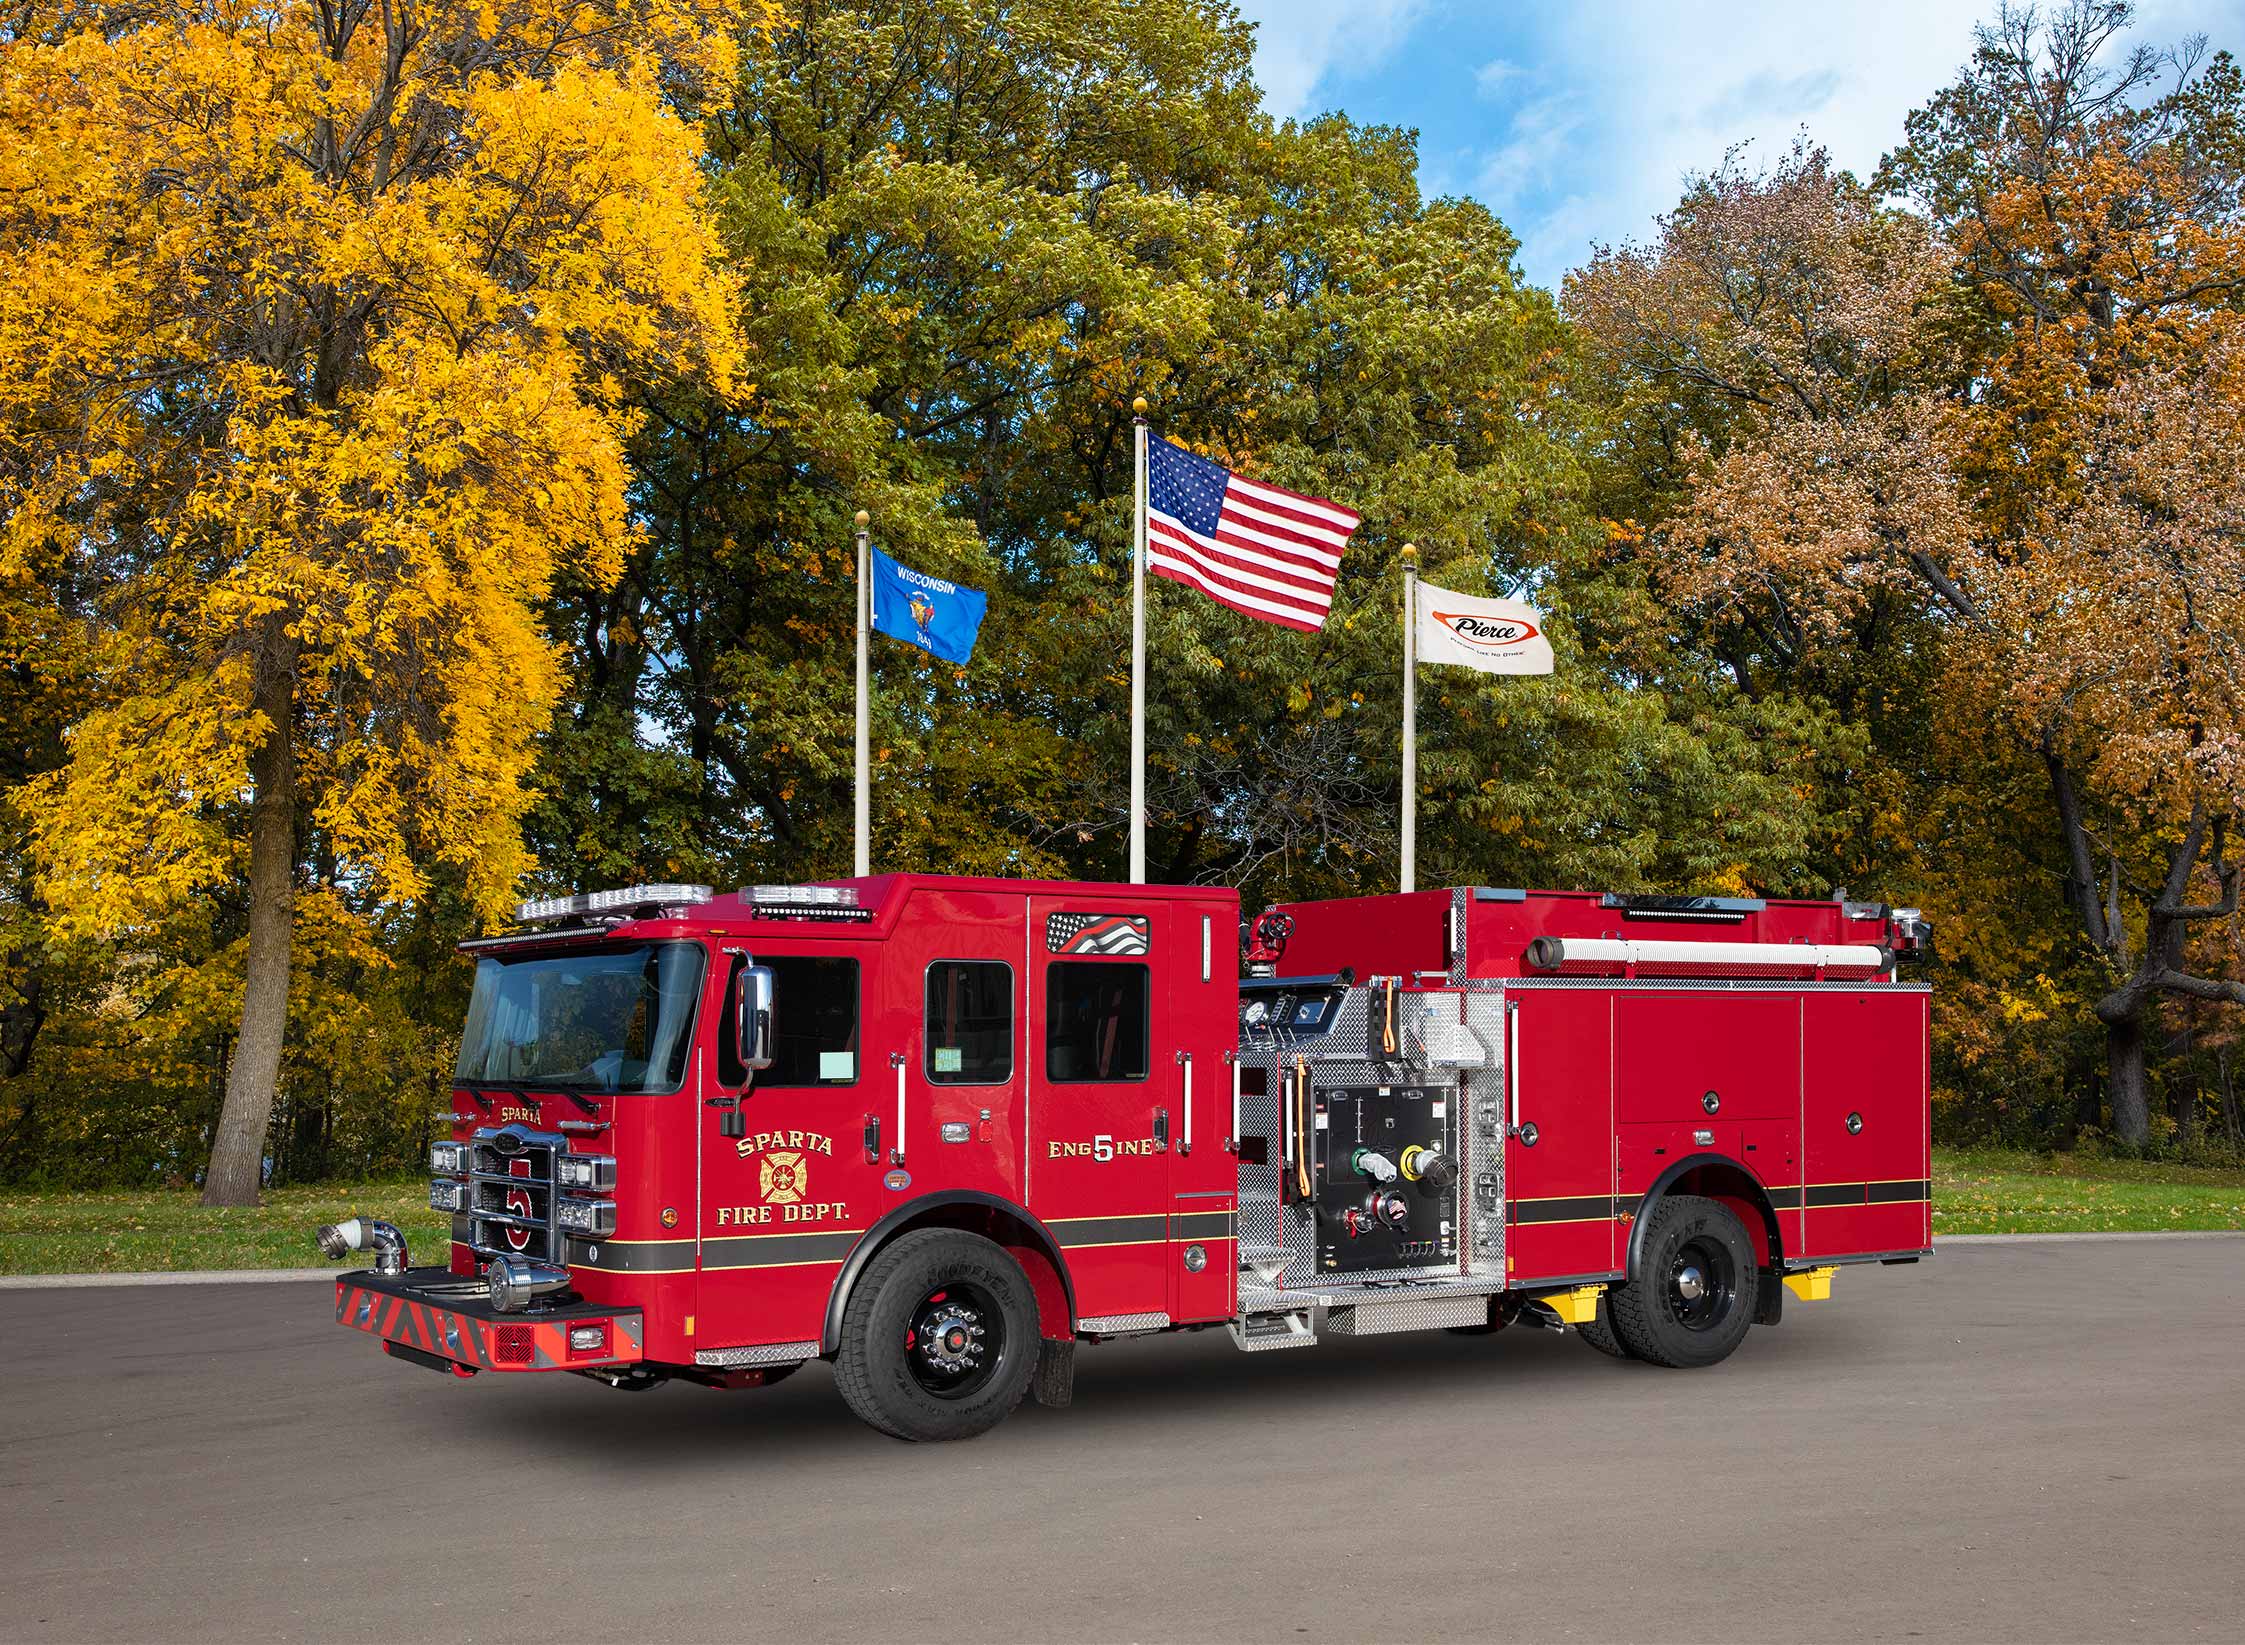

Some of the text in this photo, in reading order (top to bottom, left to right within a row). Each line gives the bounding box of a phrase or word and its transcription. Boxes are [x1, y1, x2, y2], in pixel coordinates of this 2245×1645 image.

[897, 566, 956, 595] WISCONSIN
[1455, 617, 1517, 639] Pierce
[735, 1130, 833, 1160] SPARTA
[716, 1202, 850, 1226] FIRE DEPT.
